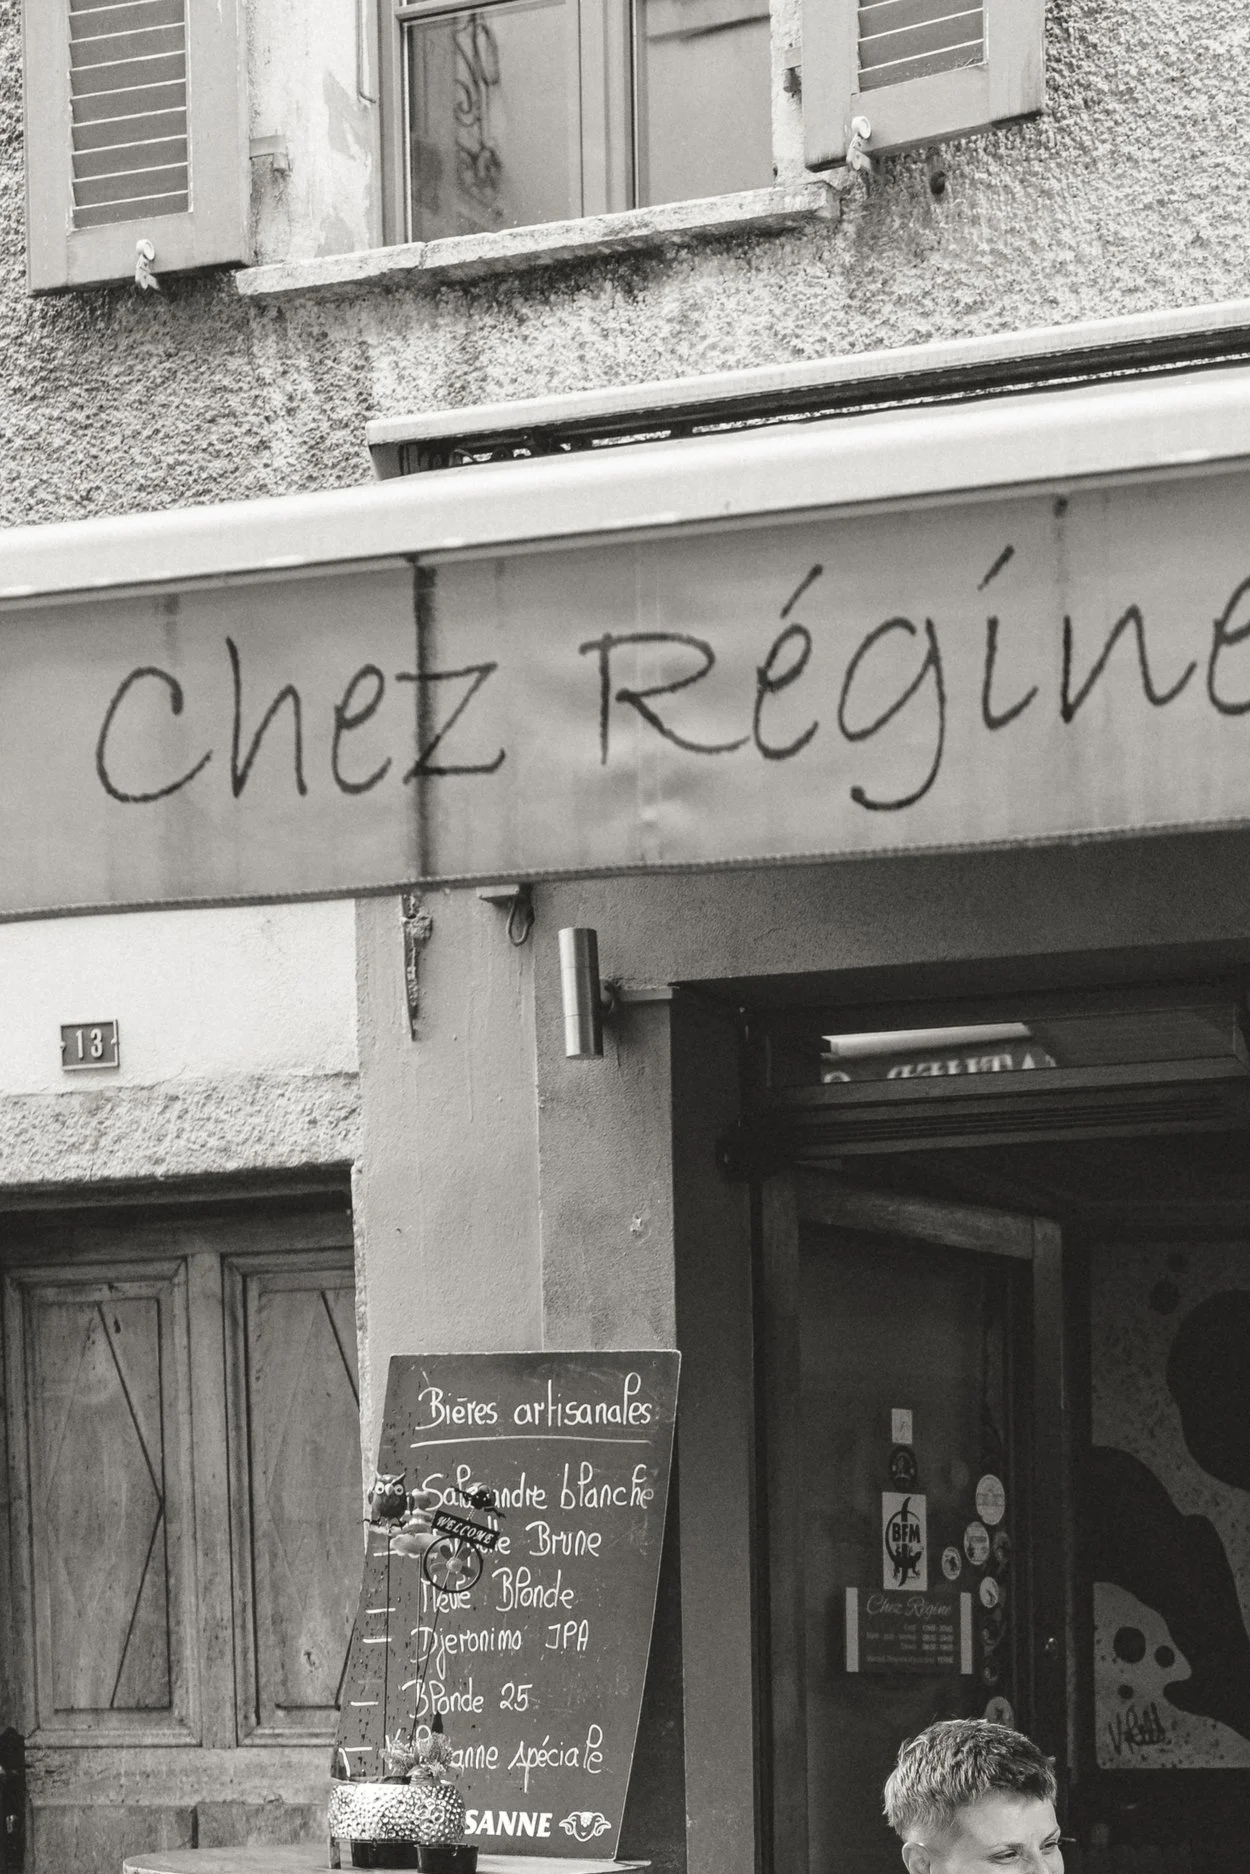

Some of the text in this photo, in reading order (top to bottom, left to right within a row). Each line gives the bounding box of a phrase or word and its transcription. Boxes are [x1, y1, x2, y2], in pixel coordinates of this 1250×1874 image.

[75, 1029, 103, 1059] 13
[514, 1372, 652, 1428] artisanales
[560, 1462, 655, 1510] blanche
[436, 1516, 495, 1544] WELCOME
[525, 1520, 602, 1557] Brune
[892, 1522, 921, 1544] BFM
[492, 1566, 574, 1612] Blonde
[402, 1677, 533, 1718] Blonde 25
[507, 1724, 603, 1793] spéciale
